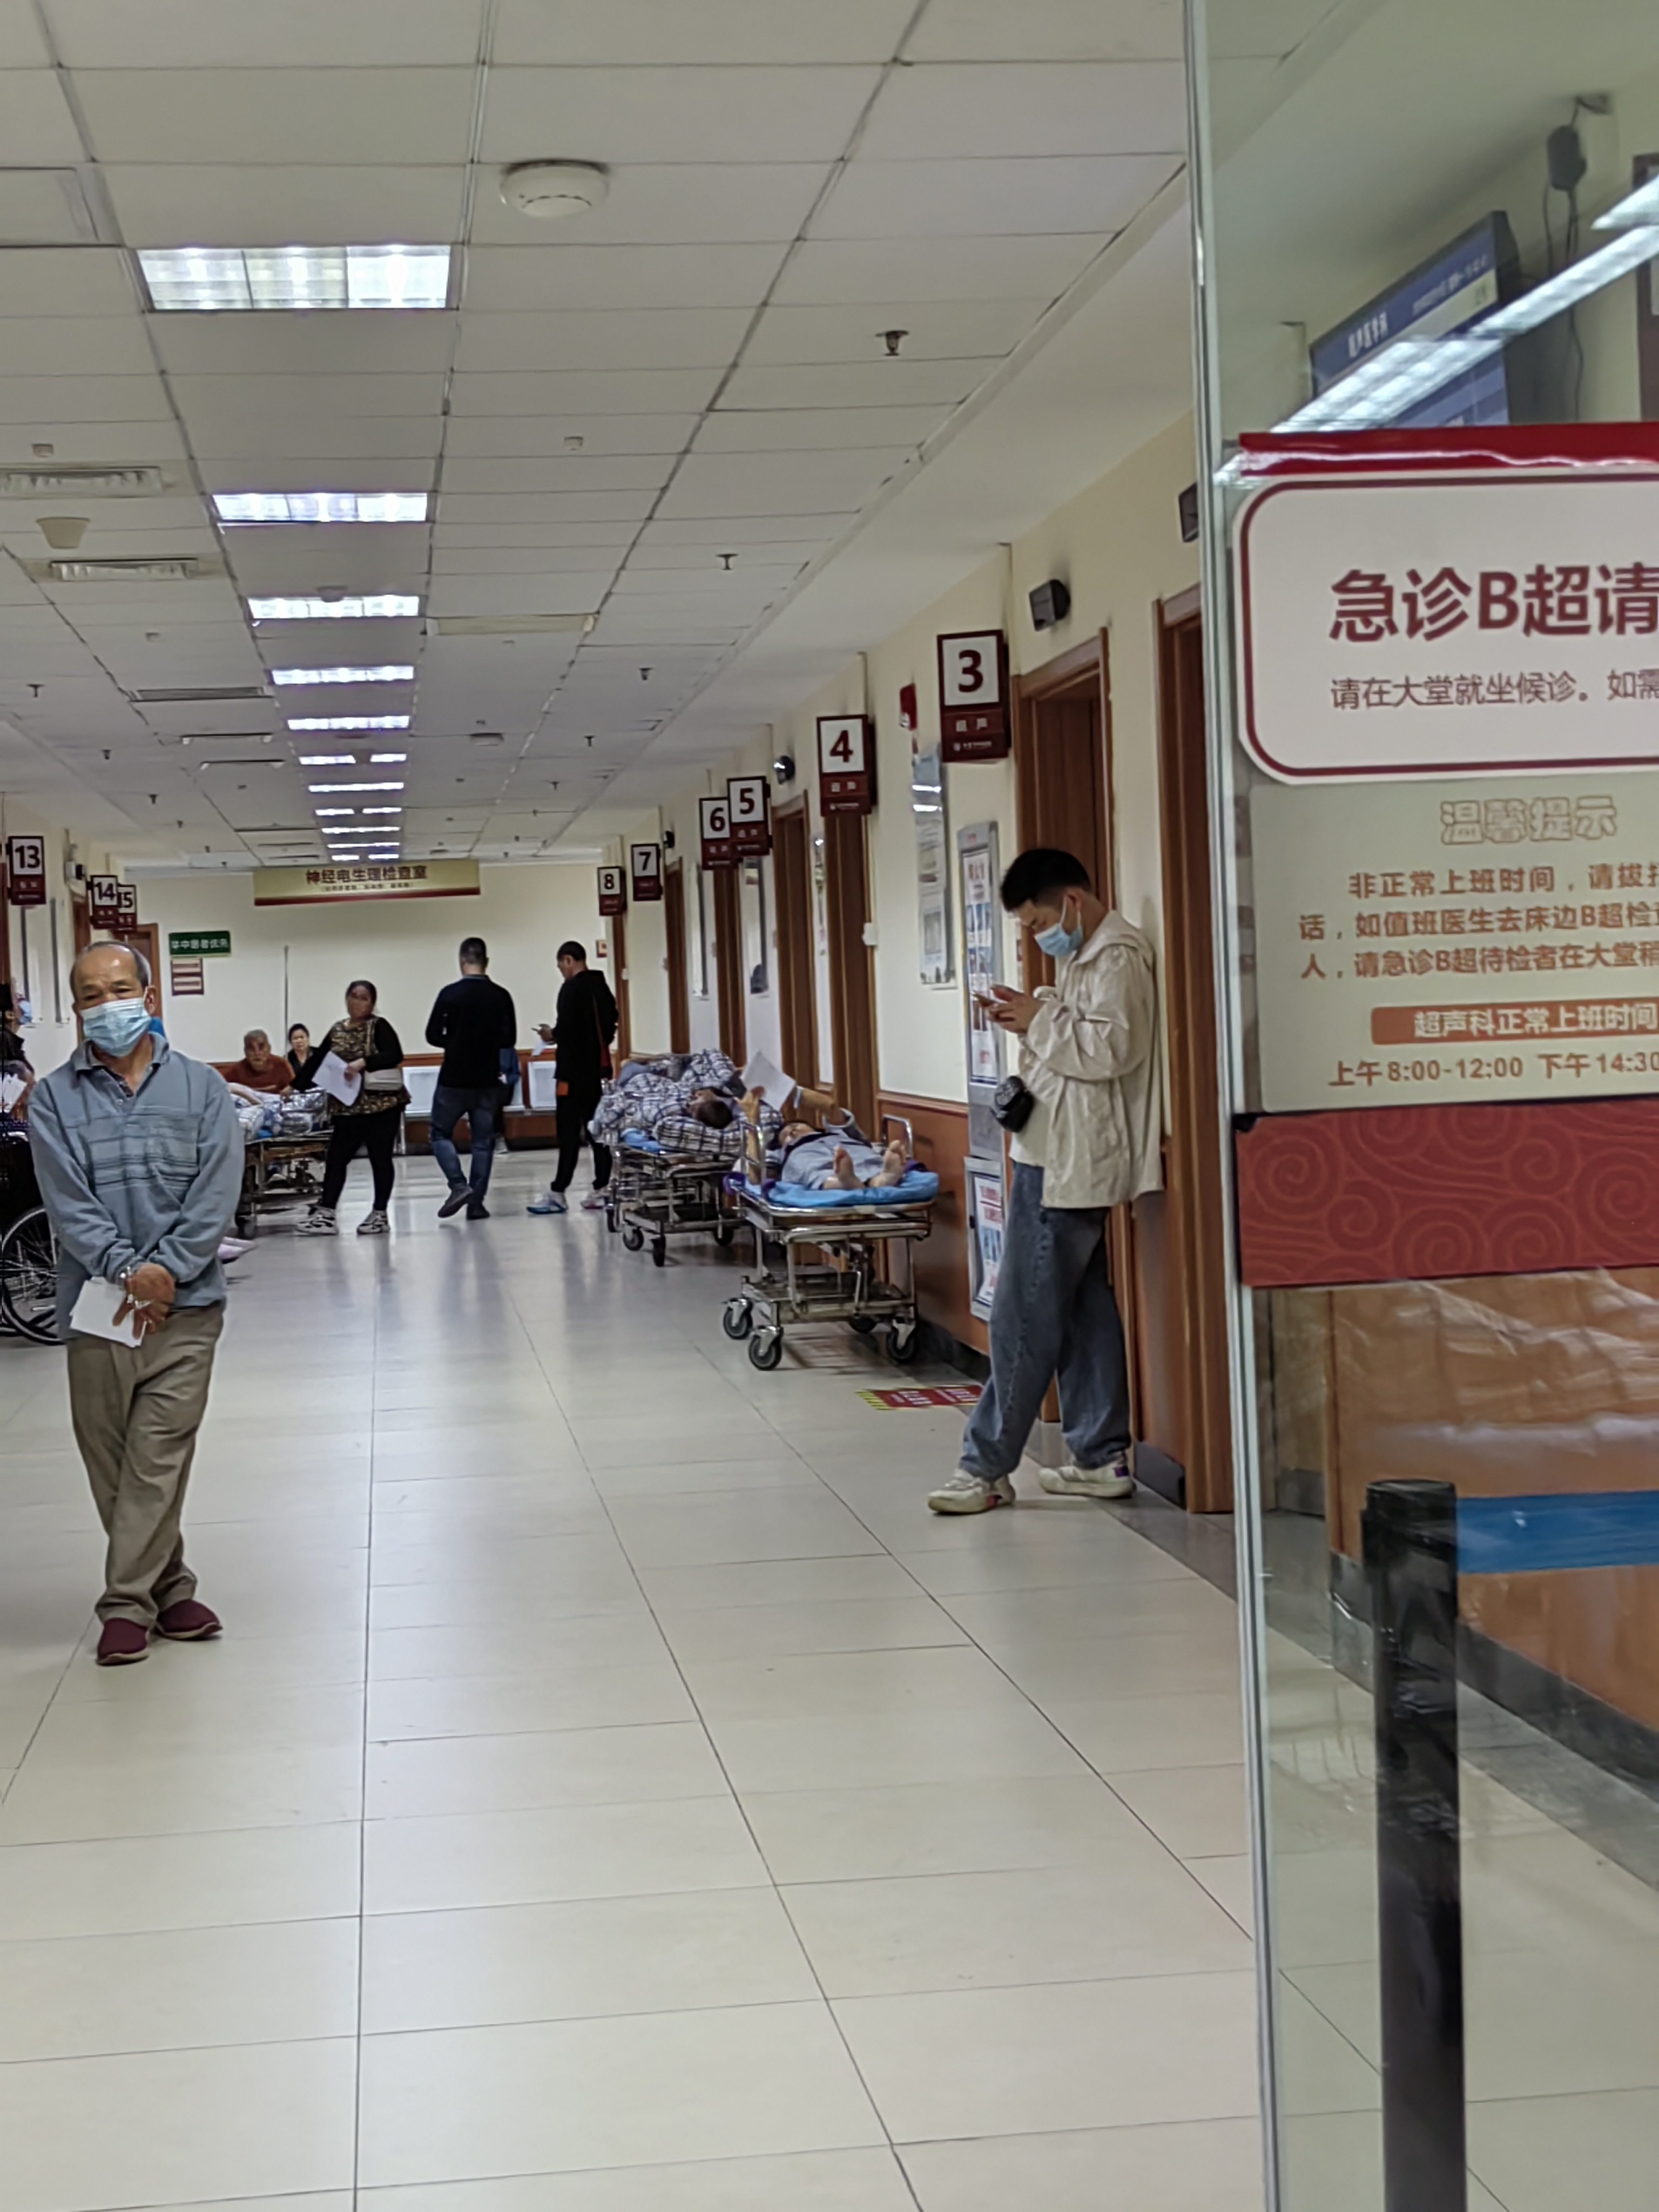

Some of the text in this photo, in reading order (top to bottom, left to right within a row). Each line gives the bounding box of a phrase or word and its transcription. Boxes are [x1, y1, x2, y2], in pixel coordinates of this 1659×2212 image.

[1329, 562, 1659, 643] 急诊B超请
[957, 649, 984, 693] 3
[829, 729, 854, 763] 4
[739, 787, 755, 815] 5
[709, 807, 725, 832] 6
[1440, 794, 1617, 846] 温馨提示
[15, 845, 41, 869] 13
[638, 851, 651, 871] 7
[95, 881, 117, 901] 14
[604, 873, 615, 891] 8
[1299, 901, 1659, 941] 话，如值班医生去床边B超检
[1414, 1003, 1658, 1037] 超声科正常上班时间
